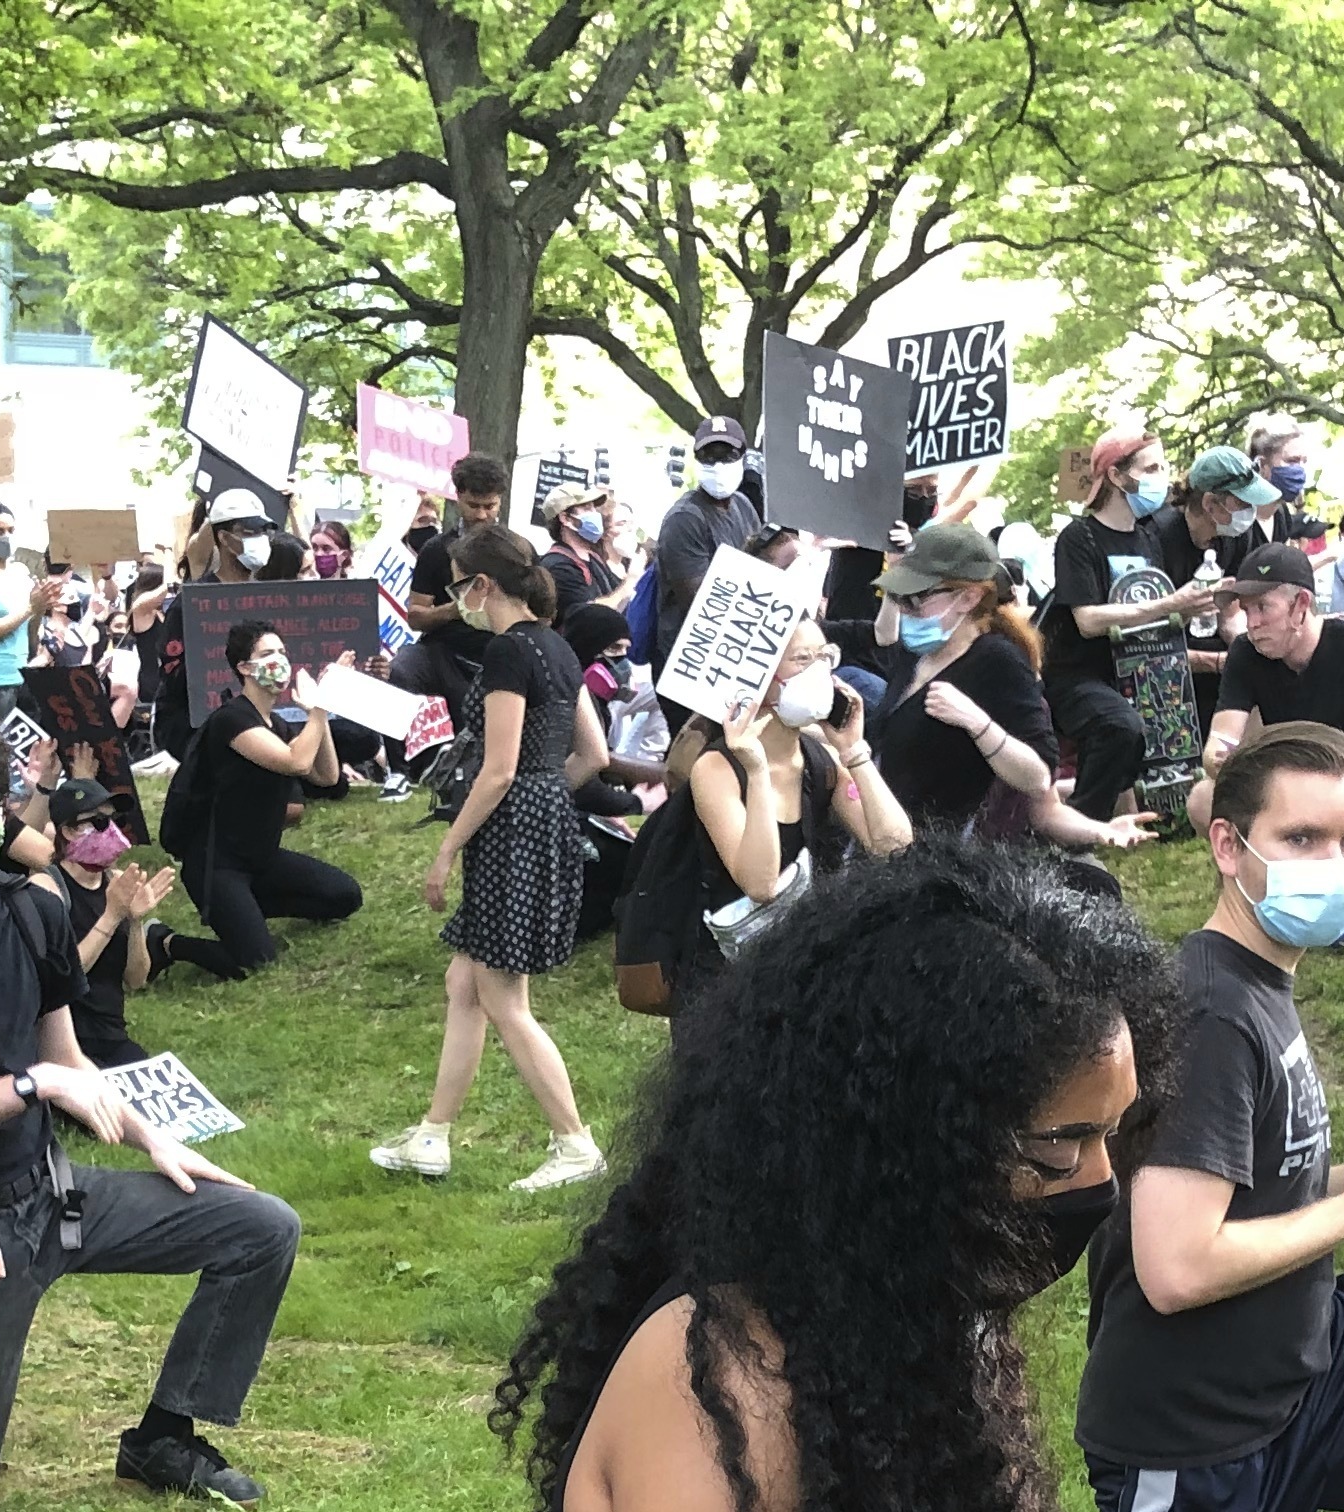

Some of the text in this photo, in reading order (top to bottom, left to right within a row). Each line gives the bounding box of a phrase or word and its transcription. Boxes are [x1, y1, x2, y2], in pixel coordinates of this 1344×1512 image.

[813, 358, 864, 403] SAY
[897, 324, 1006, 384] BLACK
[806, 395, 863, 435] THEIR
[907, 374, 998, 434] IVES
[374, 426, 455, 469] POLICE
[798, 424, 868, 483] NAMES
[906, 418, 1002, 467] MATTER
[374, 547, 415, 599] HAT
[673, 577, 739, 681] HONG KONG
[706, 581, 774, 687] 4 BLACK
[736, 600, 794, 691] LIVES
